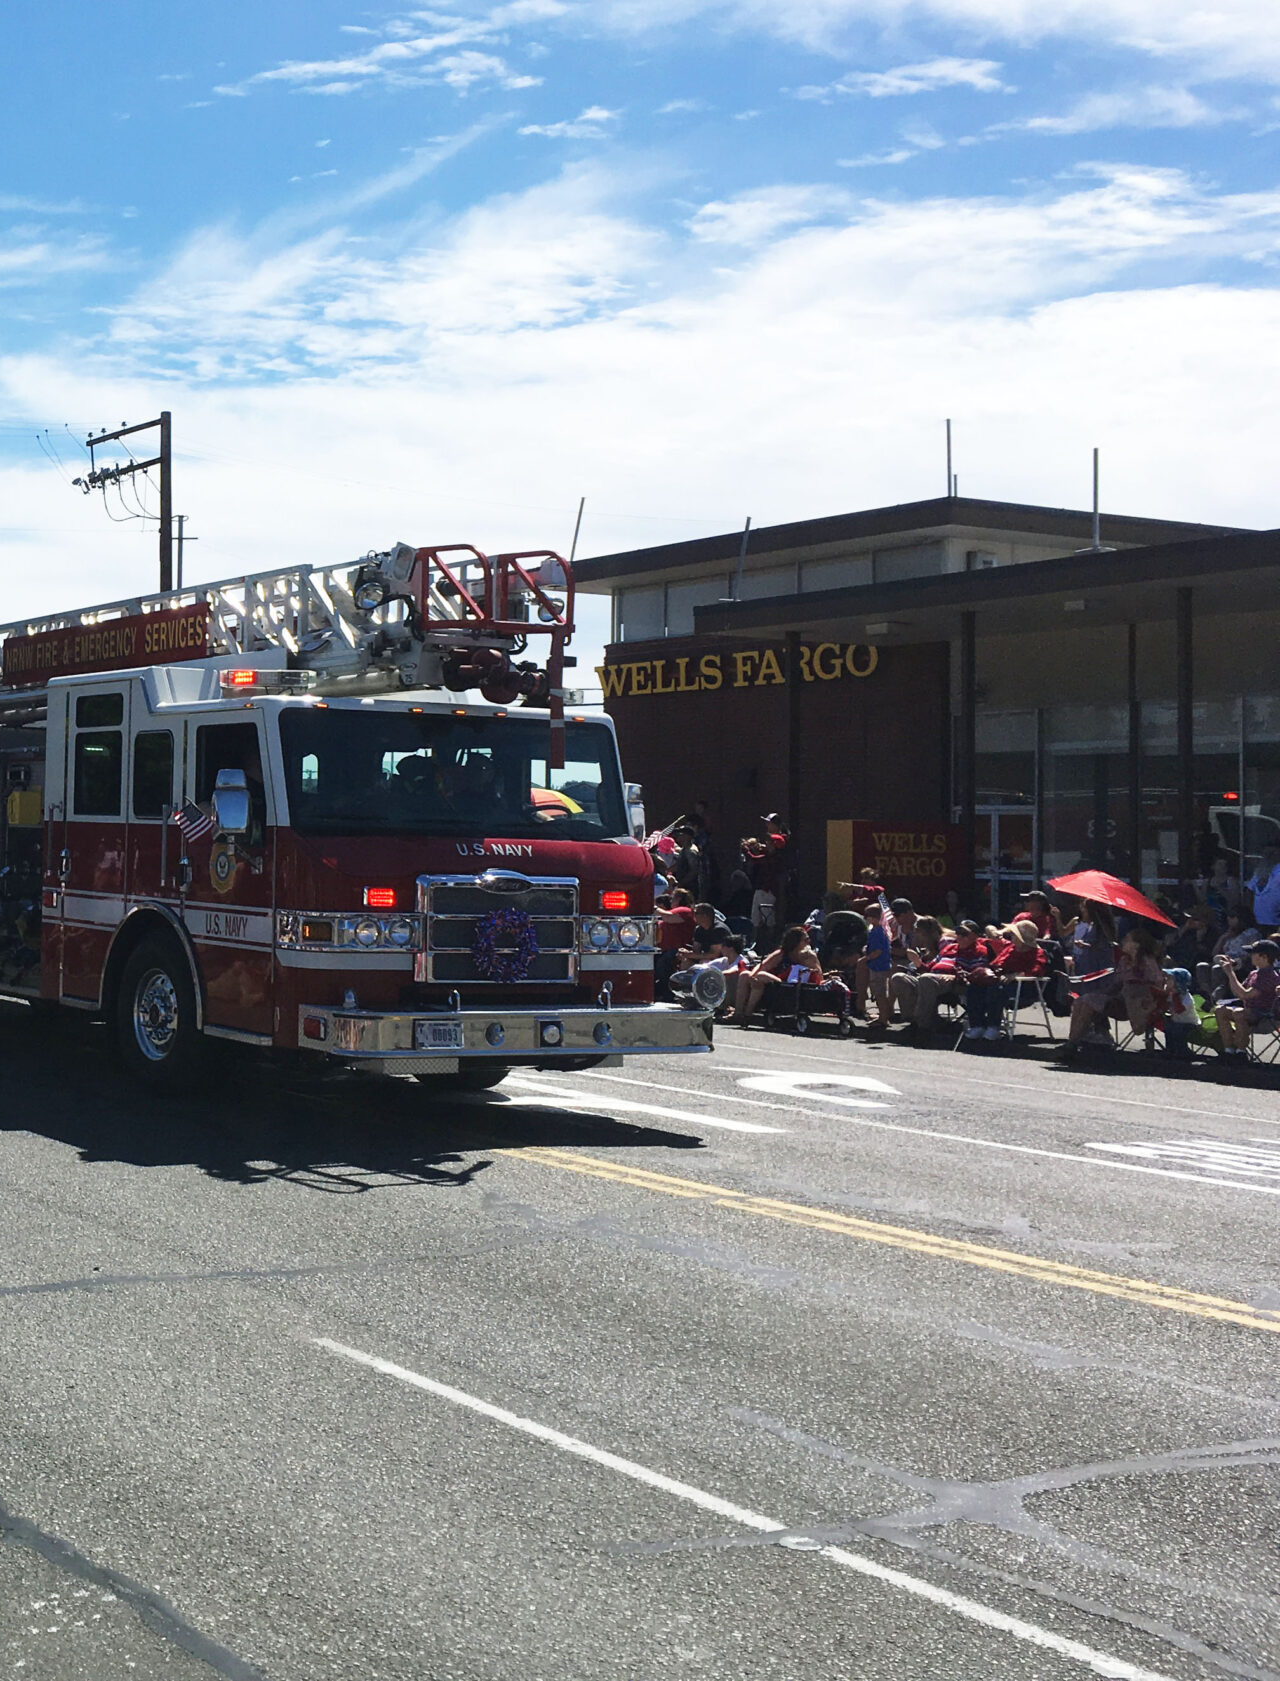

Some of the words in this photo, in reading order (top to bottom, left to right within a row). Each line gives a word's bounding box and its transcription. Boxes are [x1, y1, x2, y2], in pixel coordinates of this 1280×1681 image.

[36, 640, 58, 669] FIRE
[62, 639, 70, 665] &
[74, 627, 137, 664] EMERGENCY
[145, 615, 204, 654] SERVICES
[594, 653, 723, 698] WELLS
[456, 843, 490, 856] U.S.
[490, 843, 533, 857] NAVY
[872, 832, 947, 854] WELLS
[874, 856, 947, 877] FARGO
[205, 912, 222, 935] U.S.
[224, 914, 248, 938] NAVY
